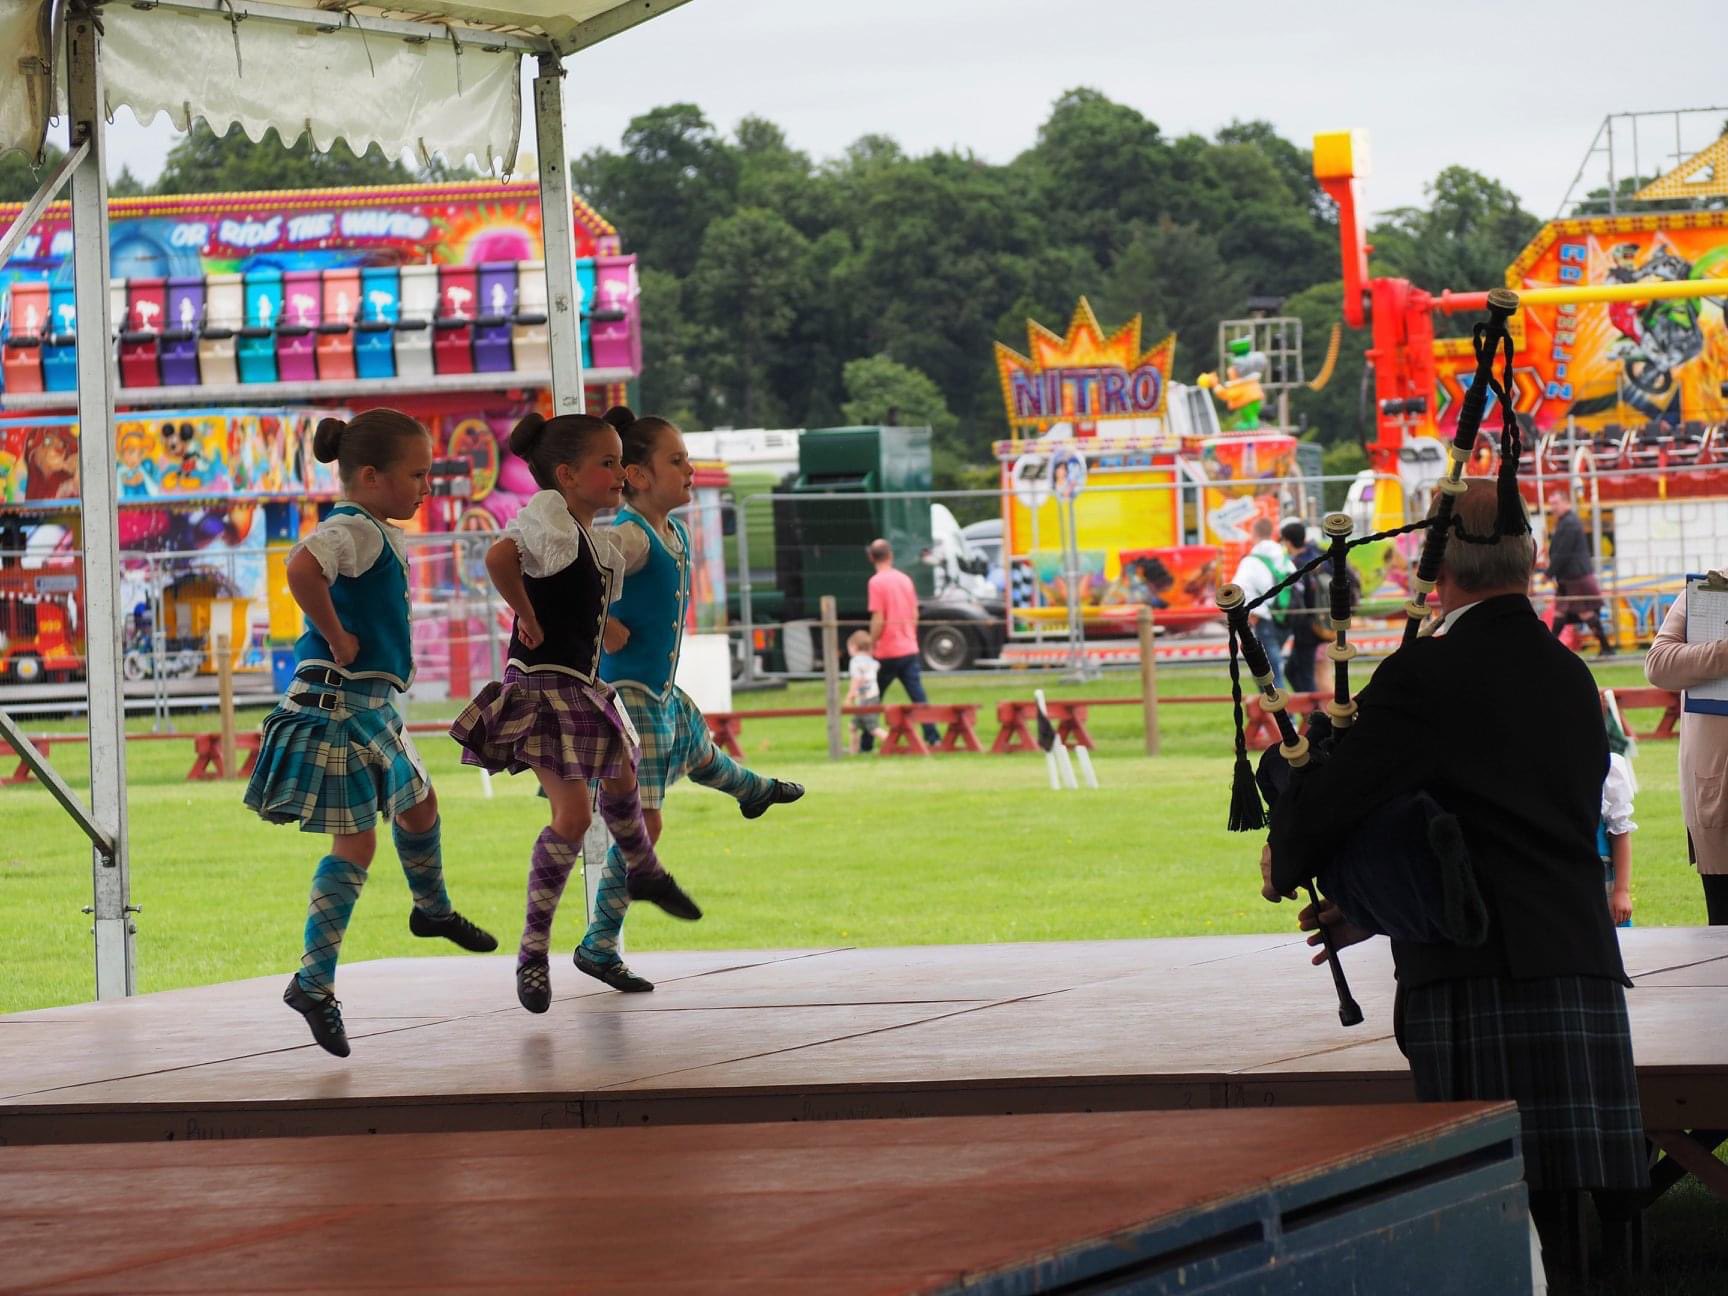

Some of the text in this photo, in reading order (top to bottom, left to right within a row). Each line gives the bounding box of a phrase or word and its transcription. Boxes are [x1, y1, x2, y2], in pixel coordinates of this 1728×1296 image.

[170, 223, 209, 246] OR
[219, 215, 283, 247] RIDE
[288, 213, 334, 243] THE
[1012, 363, 1163, 417] NITRO
